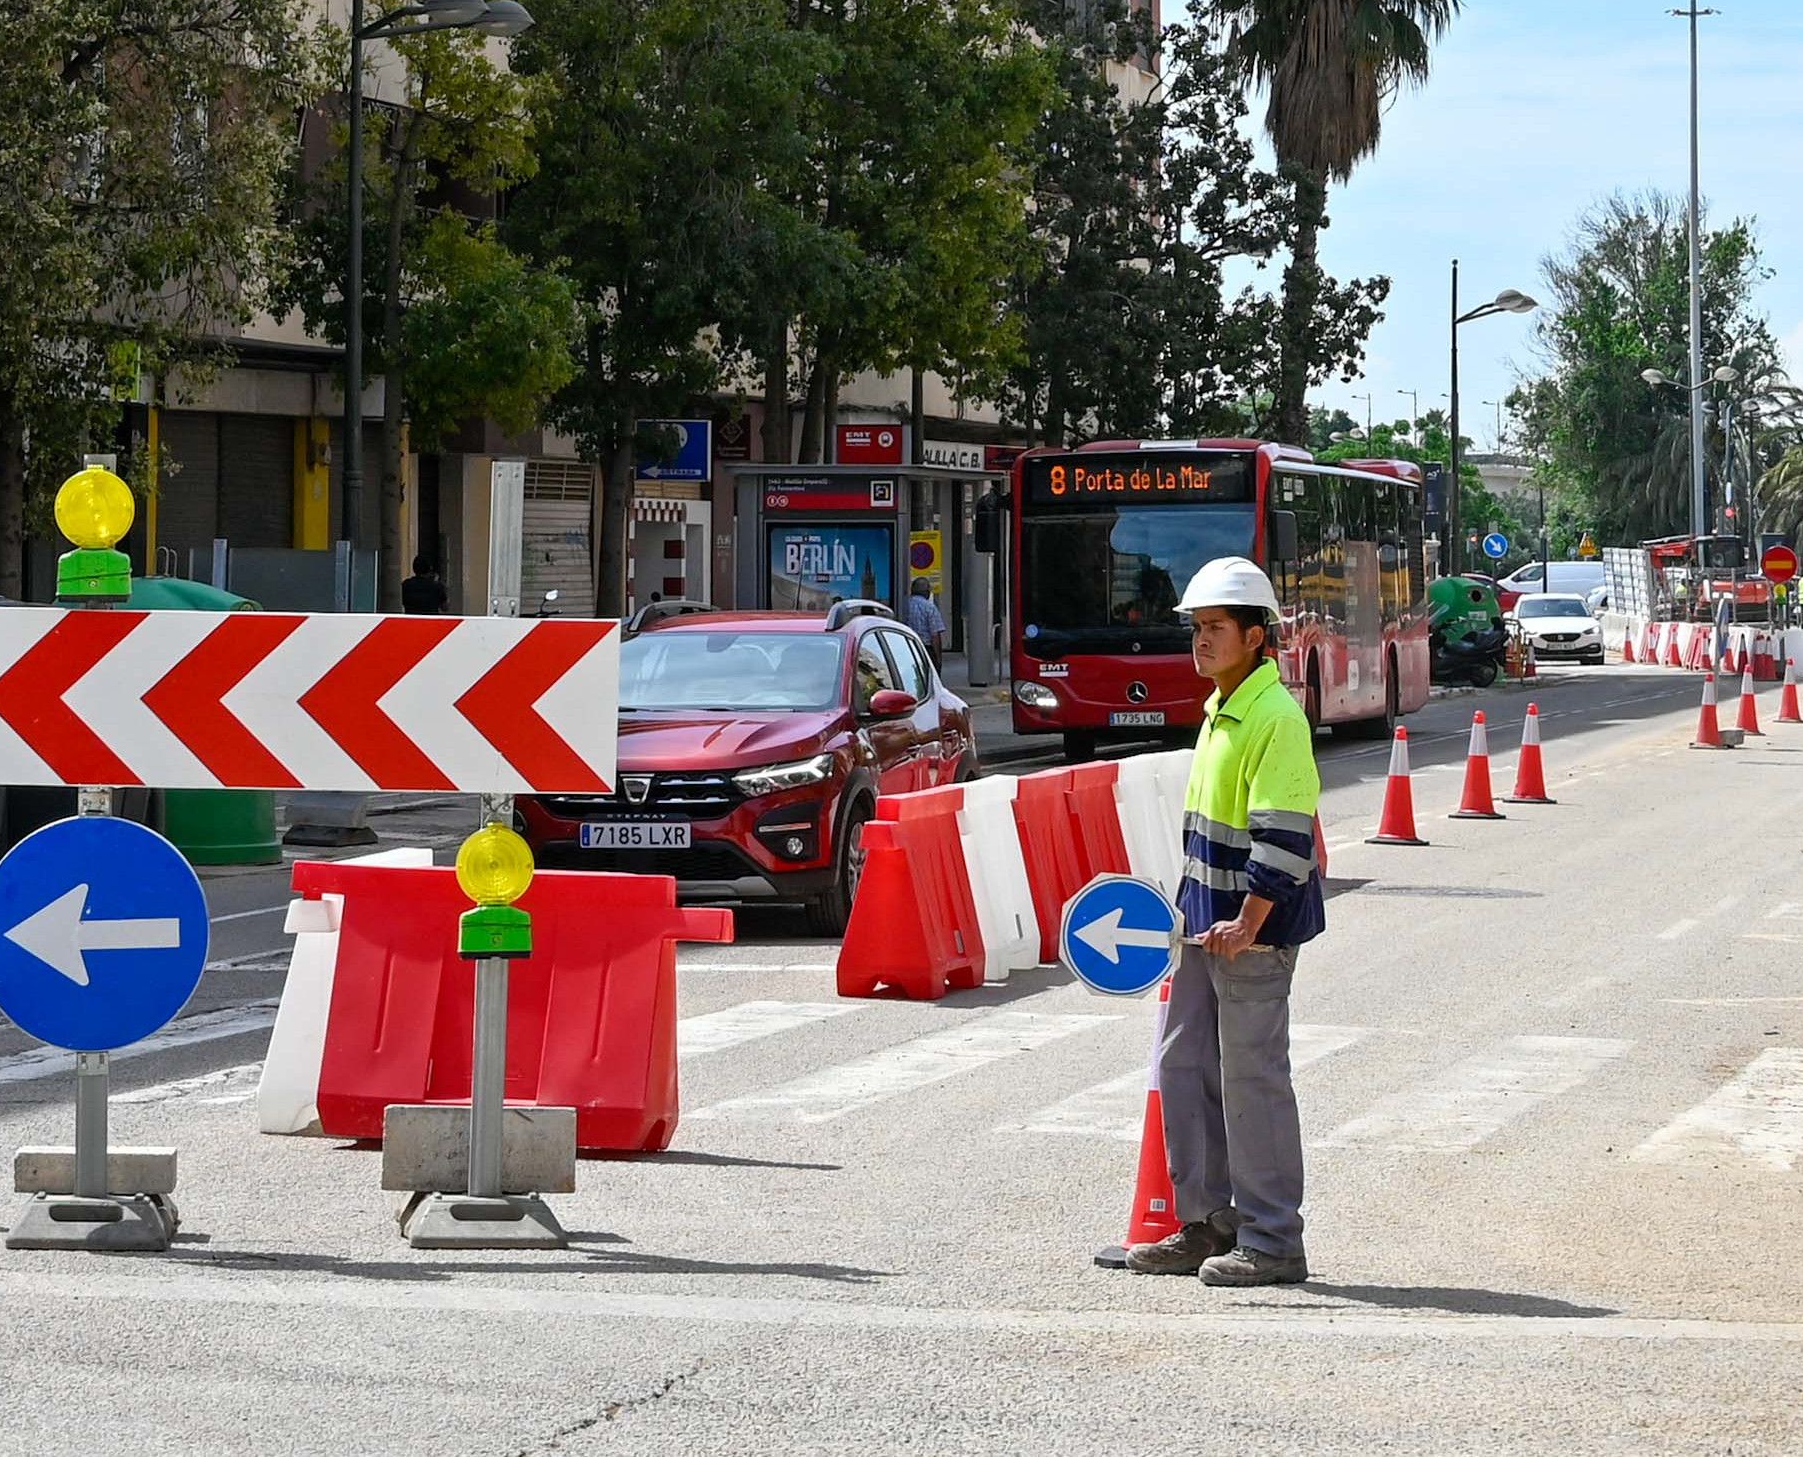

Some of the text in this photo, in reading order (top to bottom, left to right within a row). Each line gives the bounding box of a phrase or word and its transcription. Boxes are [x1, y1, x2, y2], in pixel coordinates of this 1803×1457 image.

[1051, 465, 1212, 495] 8 Porta de La Mar
[786, 538, 855, 575] BERLÍN
[1117, 713, 1139, 723] 1735
[594, 827, 685, 845] 7185 LXR
